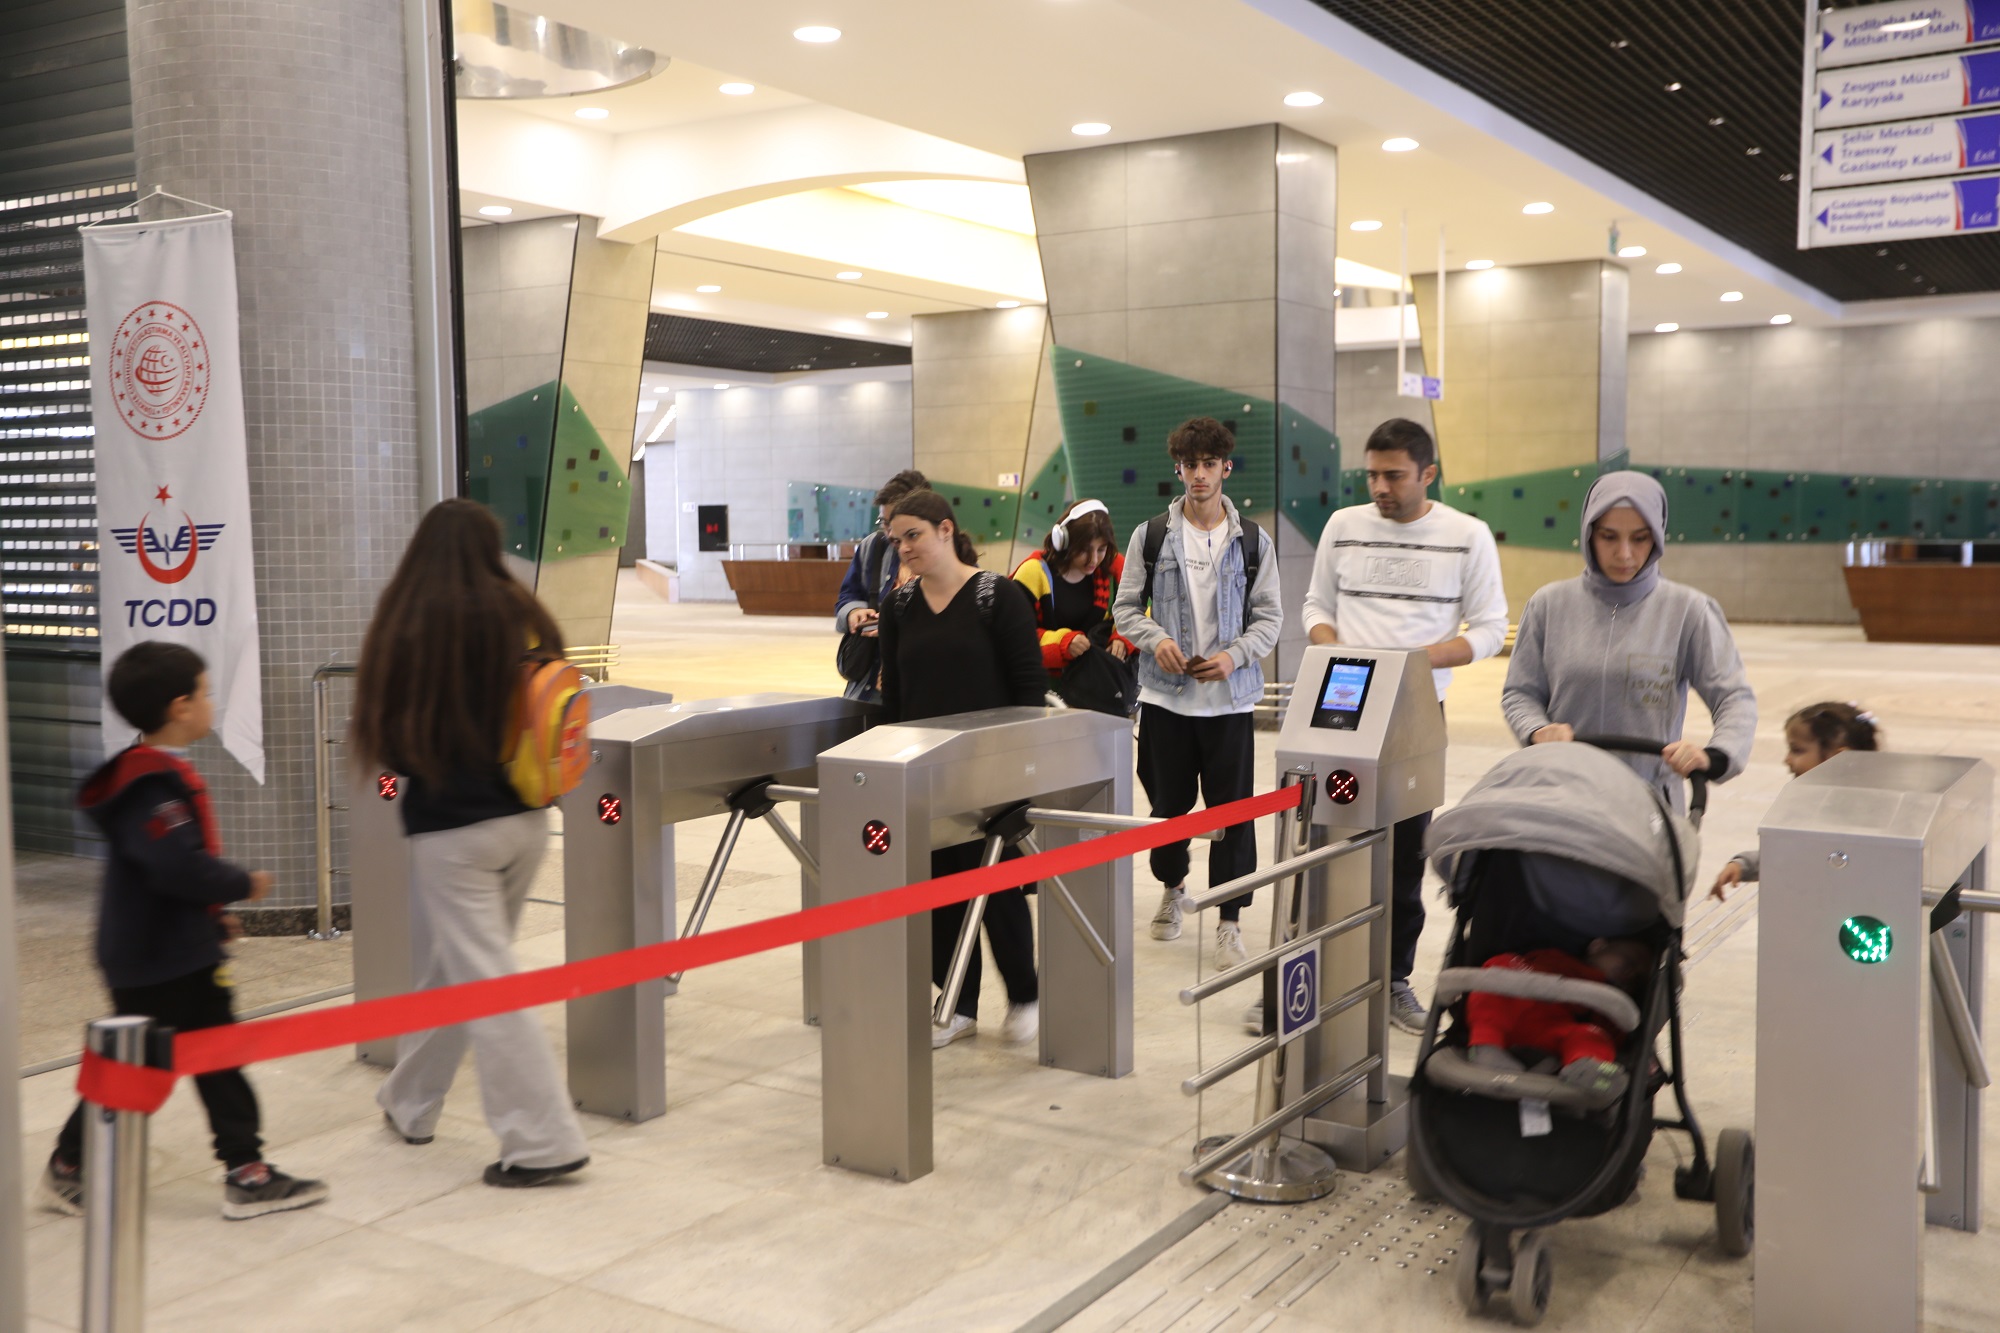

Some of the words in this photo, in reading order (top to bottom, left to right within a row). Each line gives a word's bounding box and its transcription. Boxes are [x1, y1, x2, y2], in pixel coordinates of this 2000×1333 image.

[1842, 78, 1896, 94] Zeugma
[1973, 149, 1996, 163] Exit
[1840, 159, 1908, 174] Gaziantep
[1969, 211, 1992, 225] Exit
[1369, 558, 1426, 587] AERO
[125, 598, 217, 628] TCDD
